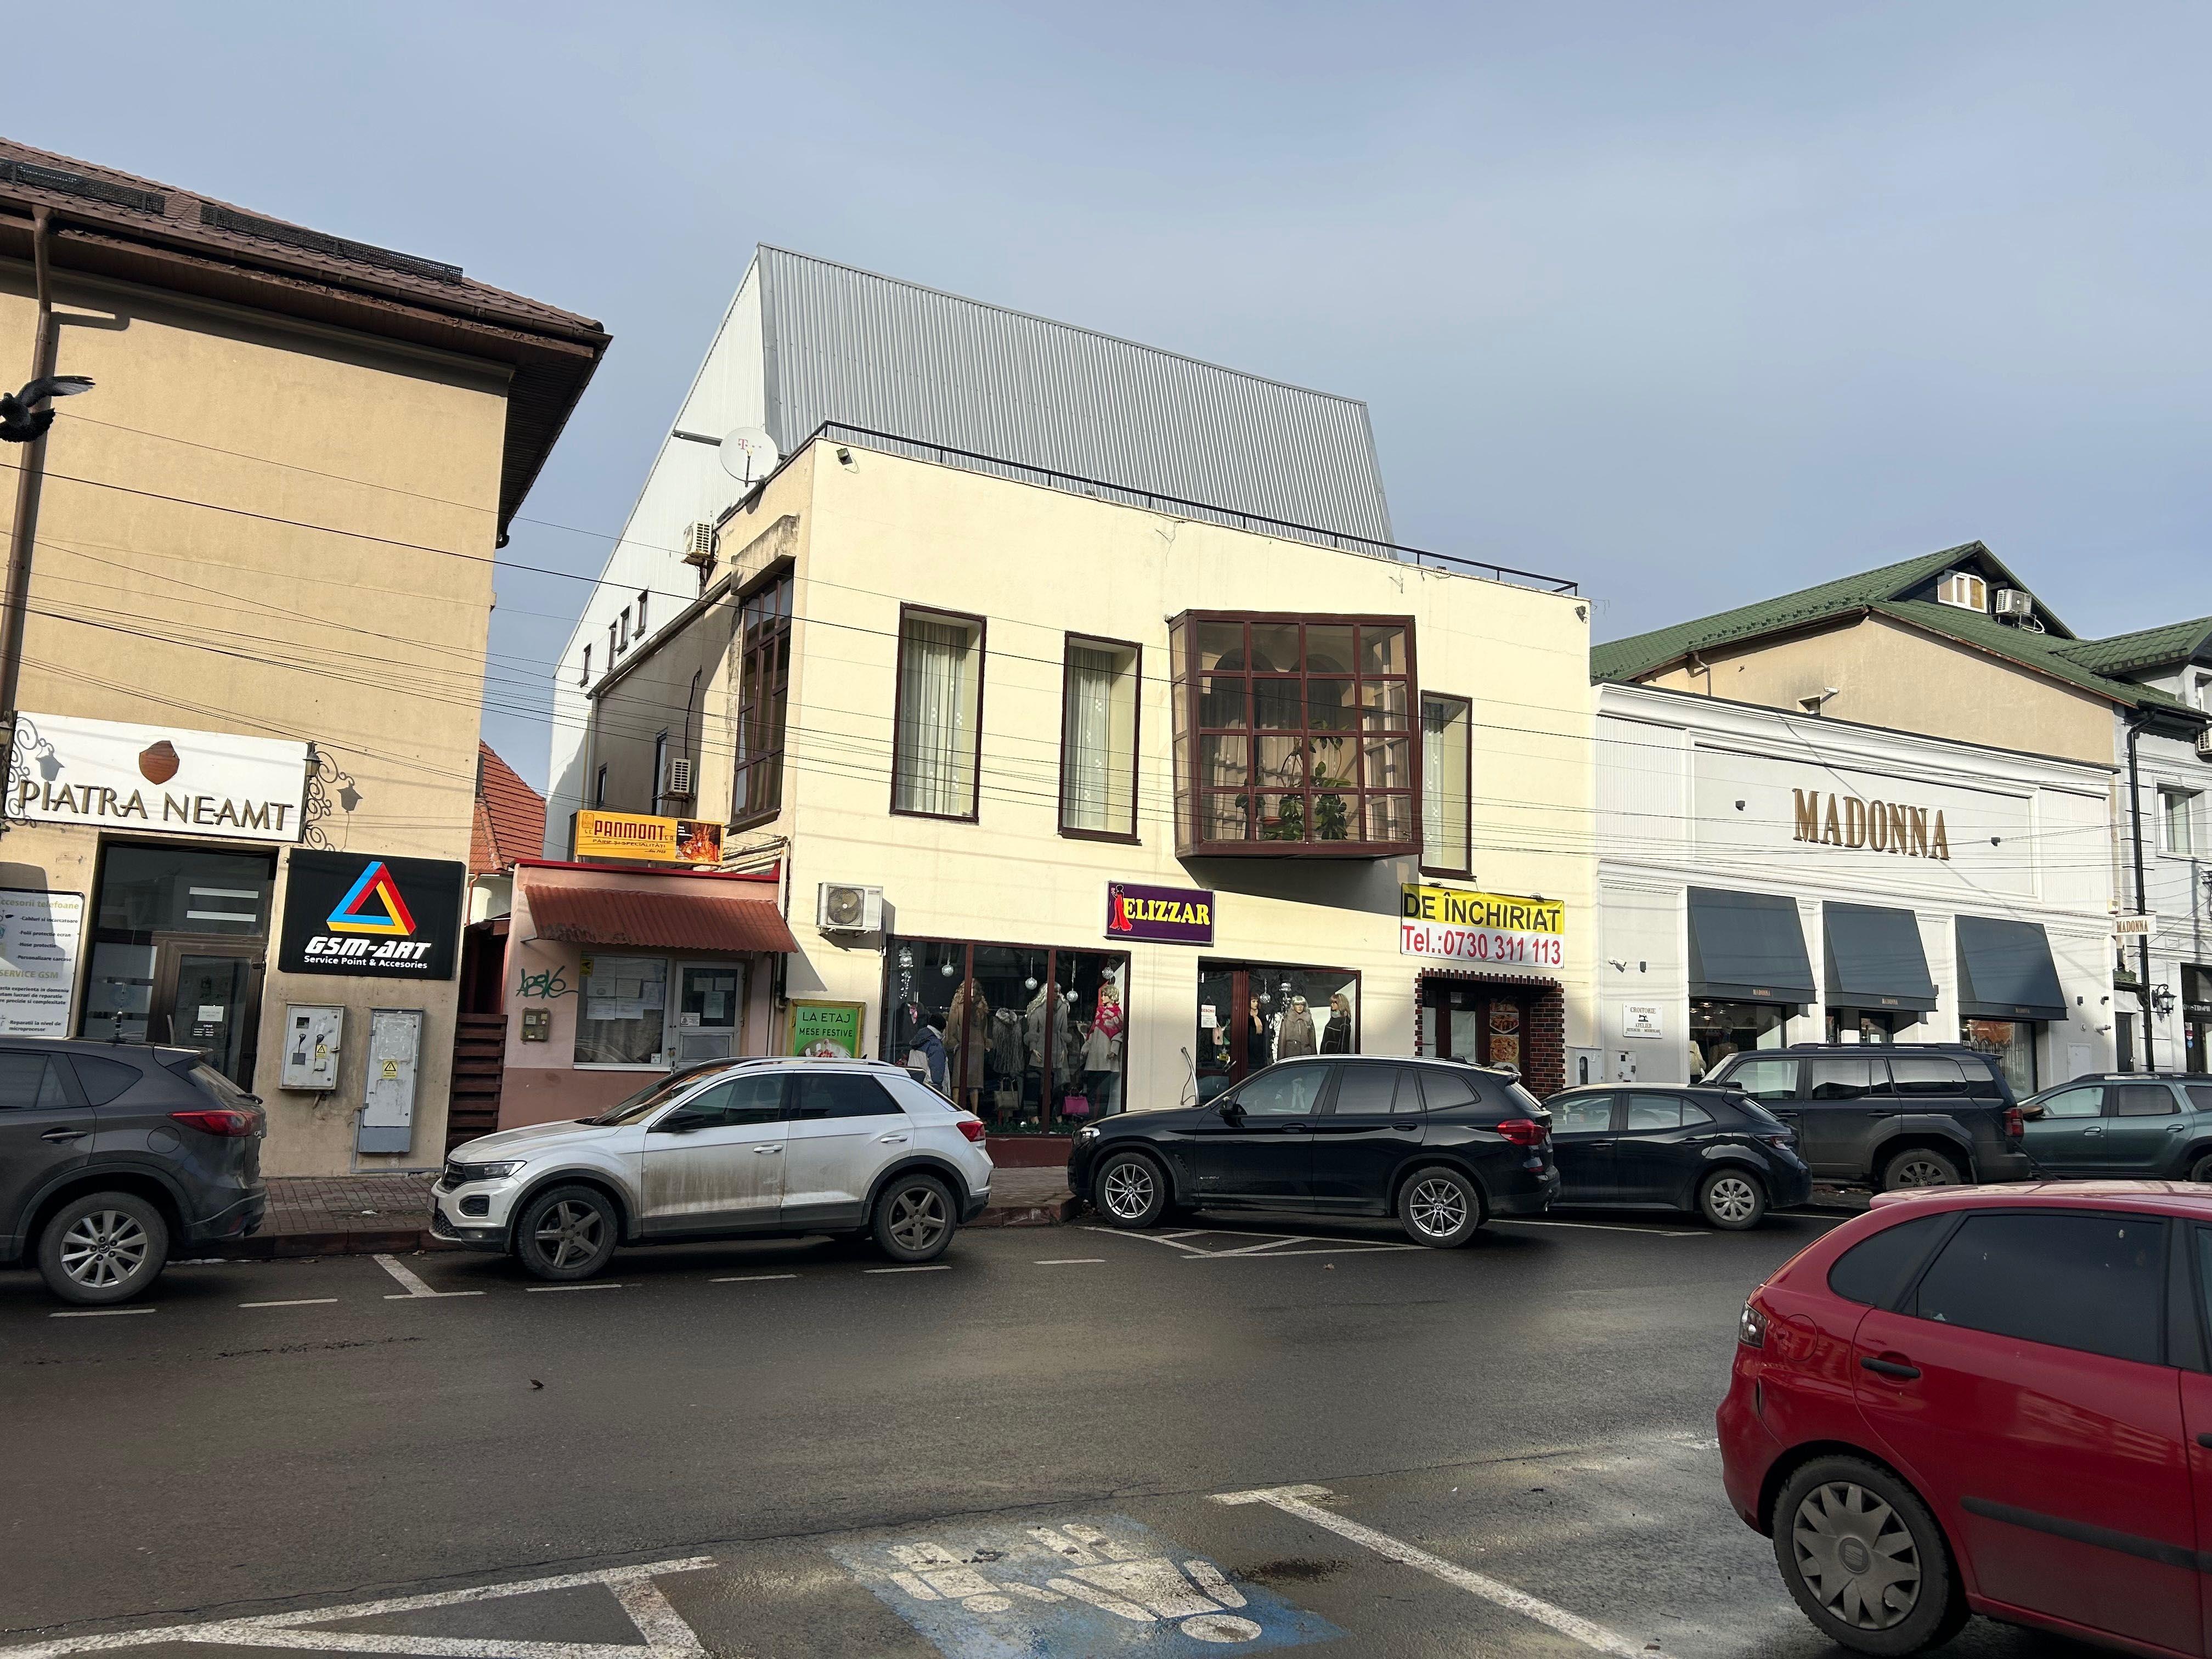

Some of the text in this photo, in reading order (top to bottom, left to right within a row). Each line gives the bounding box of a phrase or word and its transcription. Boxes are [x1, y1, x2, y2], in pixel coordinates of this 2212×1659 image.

[19, 779, 294, 831] PIATRA NEAMT
[595, 820, 665, 840] PANMONT
[1792, 788, 1951, 860] MADONNA
[37, 901, 79, 909] telefoane
[1123, 898, 1210, 925] ELIZZAR
[1403, 891, 1560, 932] DE ÎNCHIRIAT
[2116, 920, 2148, 933] MADONNA
[304, 936, 432, 959] GSM-ART
[1494, 935, 1524, 961] 311
[1532, 939, 1561, 964] 113
[304, 956, 338, 964] Service
[341, 957, 366, 966] Point
[379, 960, 427, 969] Accesories
[803, 1012, 850, 1023] LA ETAJ
[822, 1029, 853, 1037] FESTIVE
